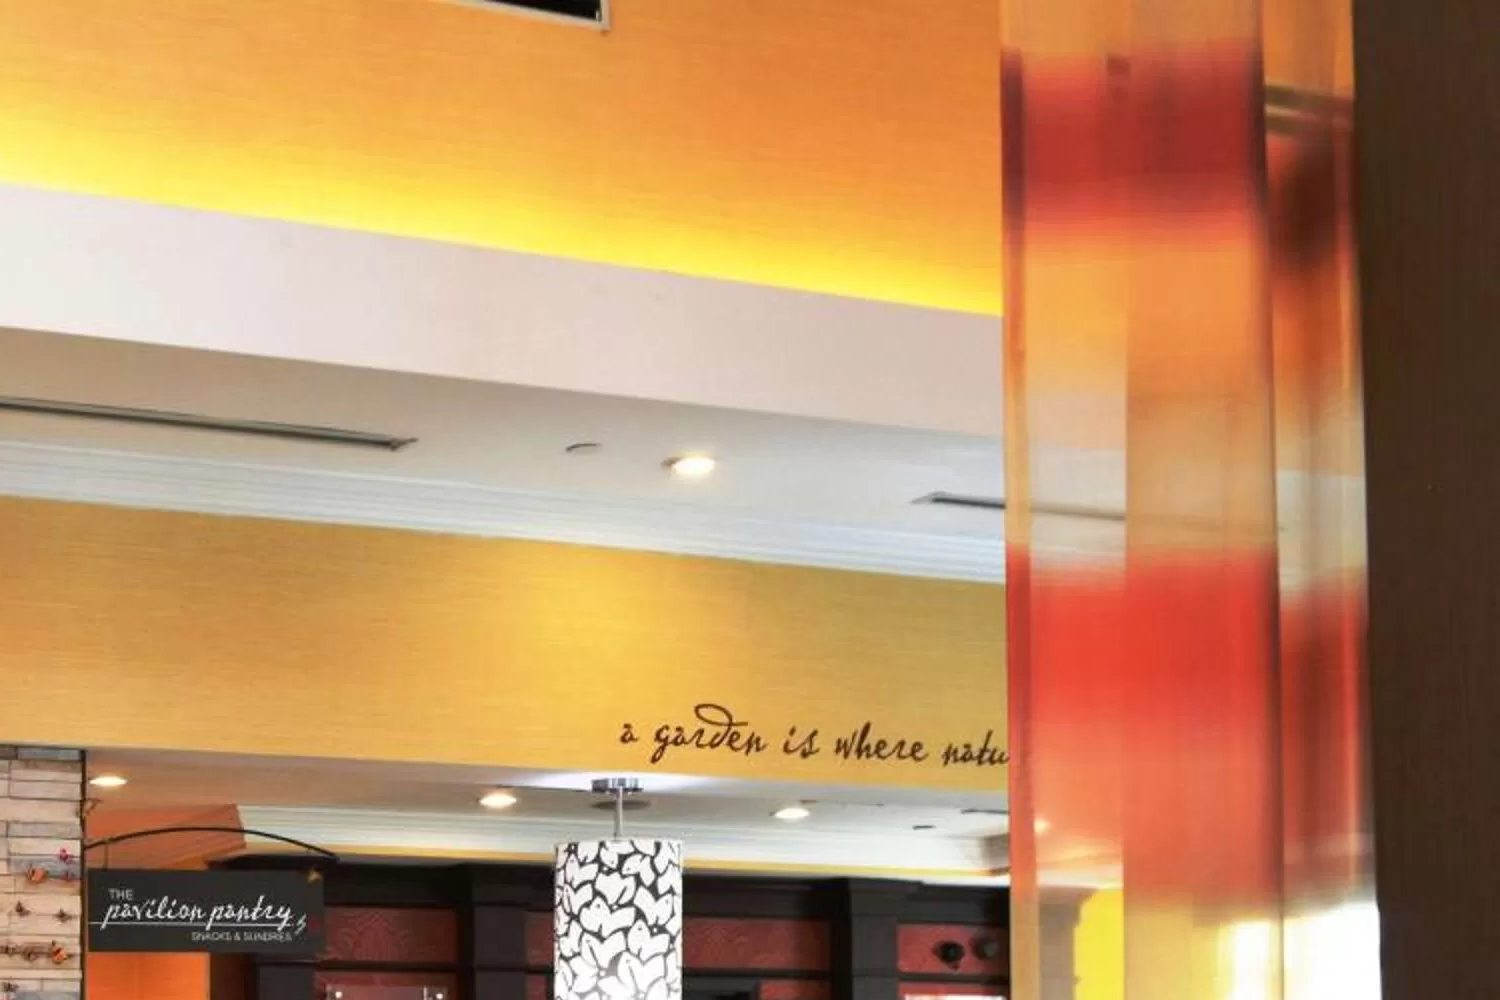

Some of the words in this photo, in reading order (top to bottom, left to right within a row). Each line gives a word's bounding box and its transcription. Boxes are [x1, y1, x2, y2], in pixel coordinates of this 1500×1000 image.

[620, 723, 639, 745] a
[650, 703, 769, 764] garden
[783, 725, 821, 759] is
[834, 722, 929, 763] where
[108, 888, 133, 900] THE
[101, 895, 205, 930] pavilion
[205, 895, 294, 931] pantry
[191, 931, 232, 941] SNACKS
[233, 932, 241, 941] &
